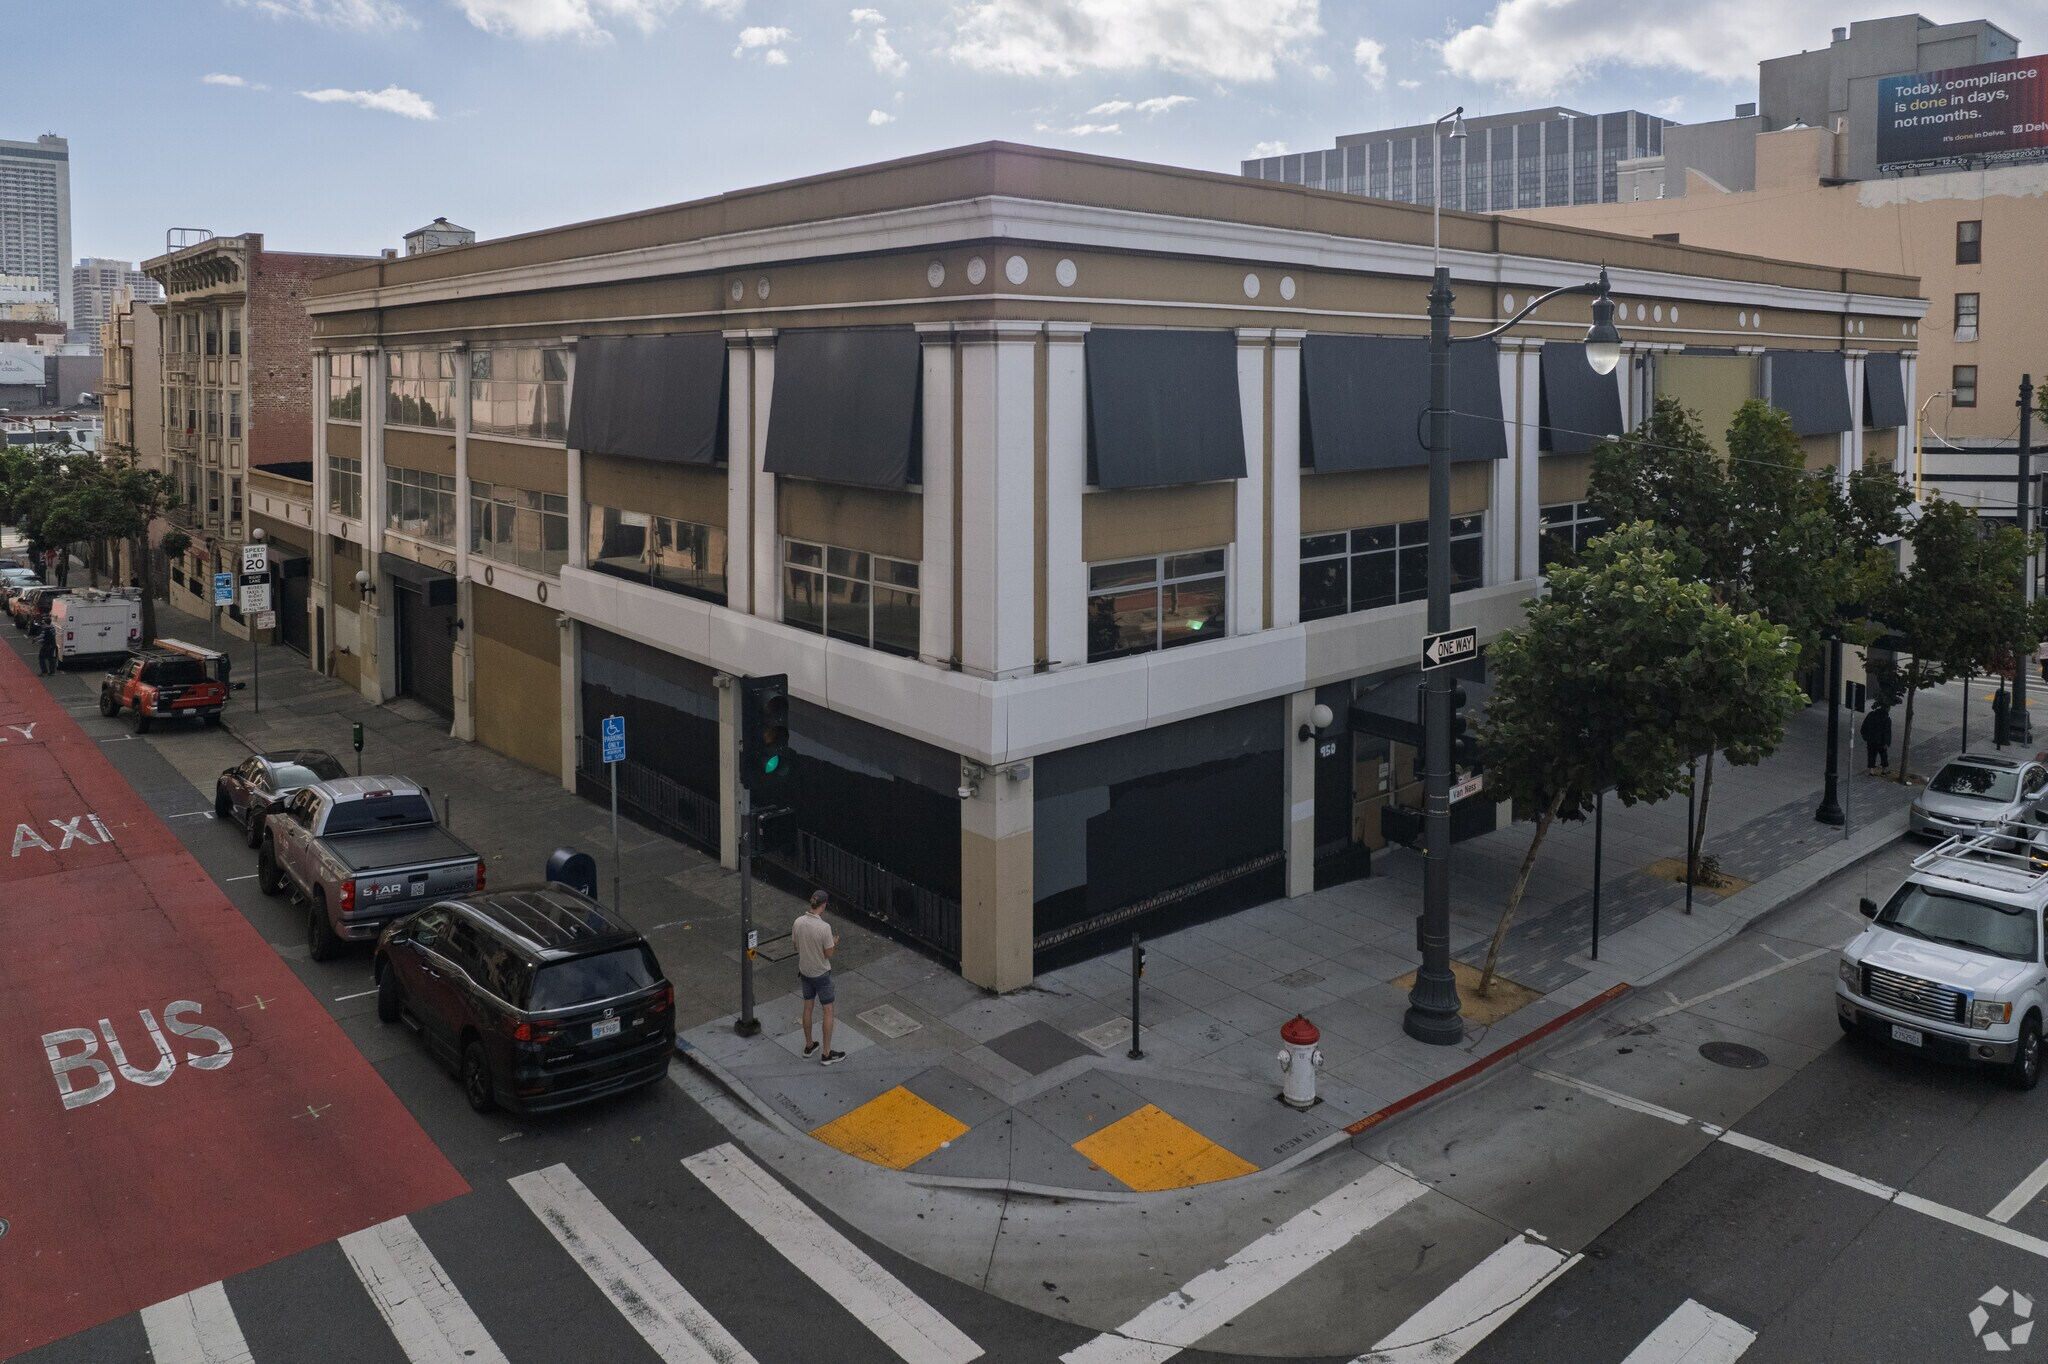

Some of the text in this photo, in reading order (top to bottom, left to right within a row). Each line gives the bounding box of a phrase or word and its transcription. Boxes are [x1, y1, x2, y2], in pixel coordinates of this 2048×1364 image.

[1895, 69, 2038, 97] Today, compliance
[1895, 89, 2010, 113] is done in days,
[1894, 109, 1982, 128] not months.
[1955, 133, 1974, 141] done
[1975, 131, 1982, 139] in
[1983, 129, 2006, 138] Delve.
[1890, 161, 1935, 171] Clear Channel
[246, 559, 264, 570] 20
[1438, 636, 1473, 657] ONE WAY
[1320, 742, 1336, 758] 950
[1453, 783, 1477, 799] Van Ness
[41, 1000, 233, 1110] BUS
